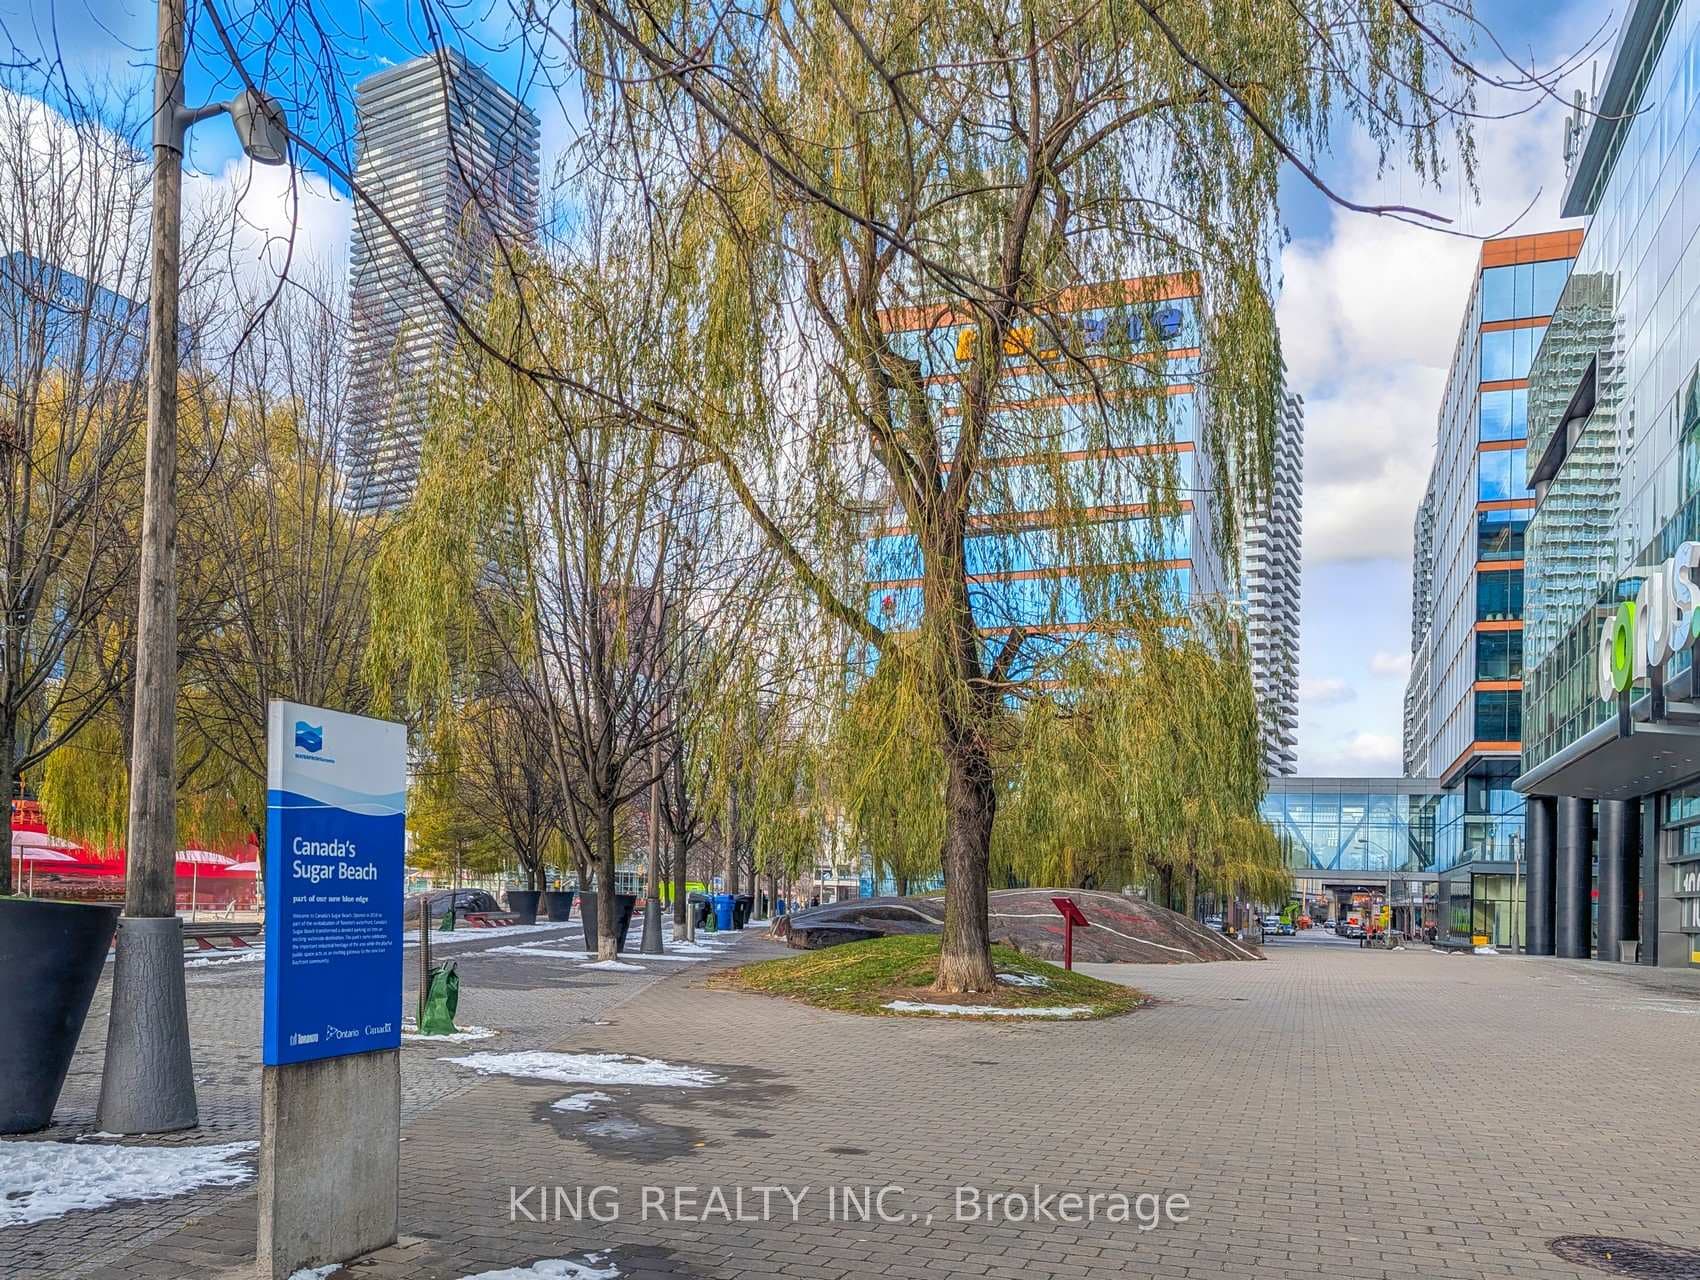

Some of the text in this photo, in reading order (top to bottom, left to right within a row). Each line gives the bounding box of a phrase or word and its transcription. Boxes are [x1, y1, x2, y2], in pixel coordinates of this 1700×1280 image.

[293, 836, 356, 858] Canada's
[293, 860, 377, 884] Sugar Beach
[292, 895, 307, 904] part
[308, 894, 316, 902] of
[355, 896, 369, 904] edge
[336, 1030, 359, 1040] Ontario
